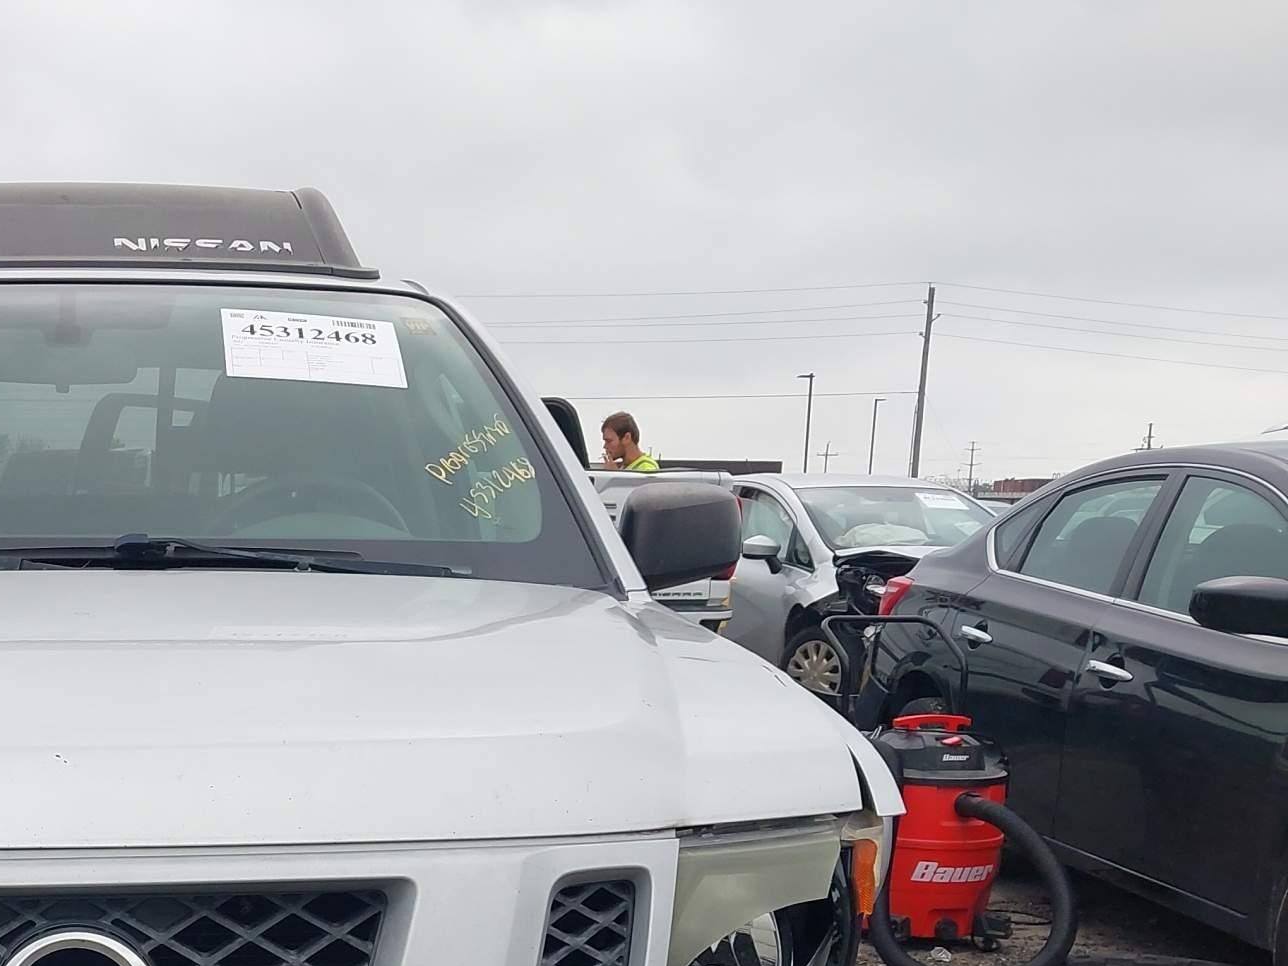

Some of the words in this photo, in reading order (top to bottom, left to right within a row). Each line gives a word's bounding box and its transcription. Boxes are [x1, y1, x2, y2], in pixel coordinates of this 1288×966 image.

[242, 324, 376, 345] 45312468
[459, 456, 536, 519] 45312468
[910, 861, 993, 883] Bauer
